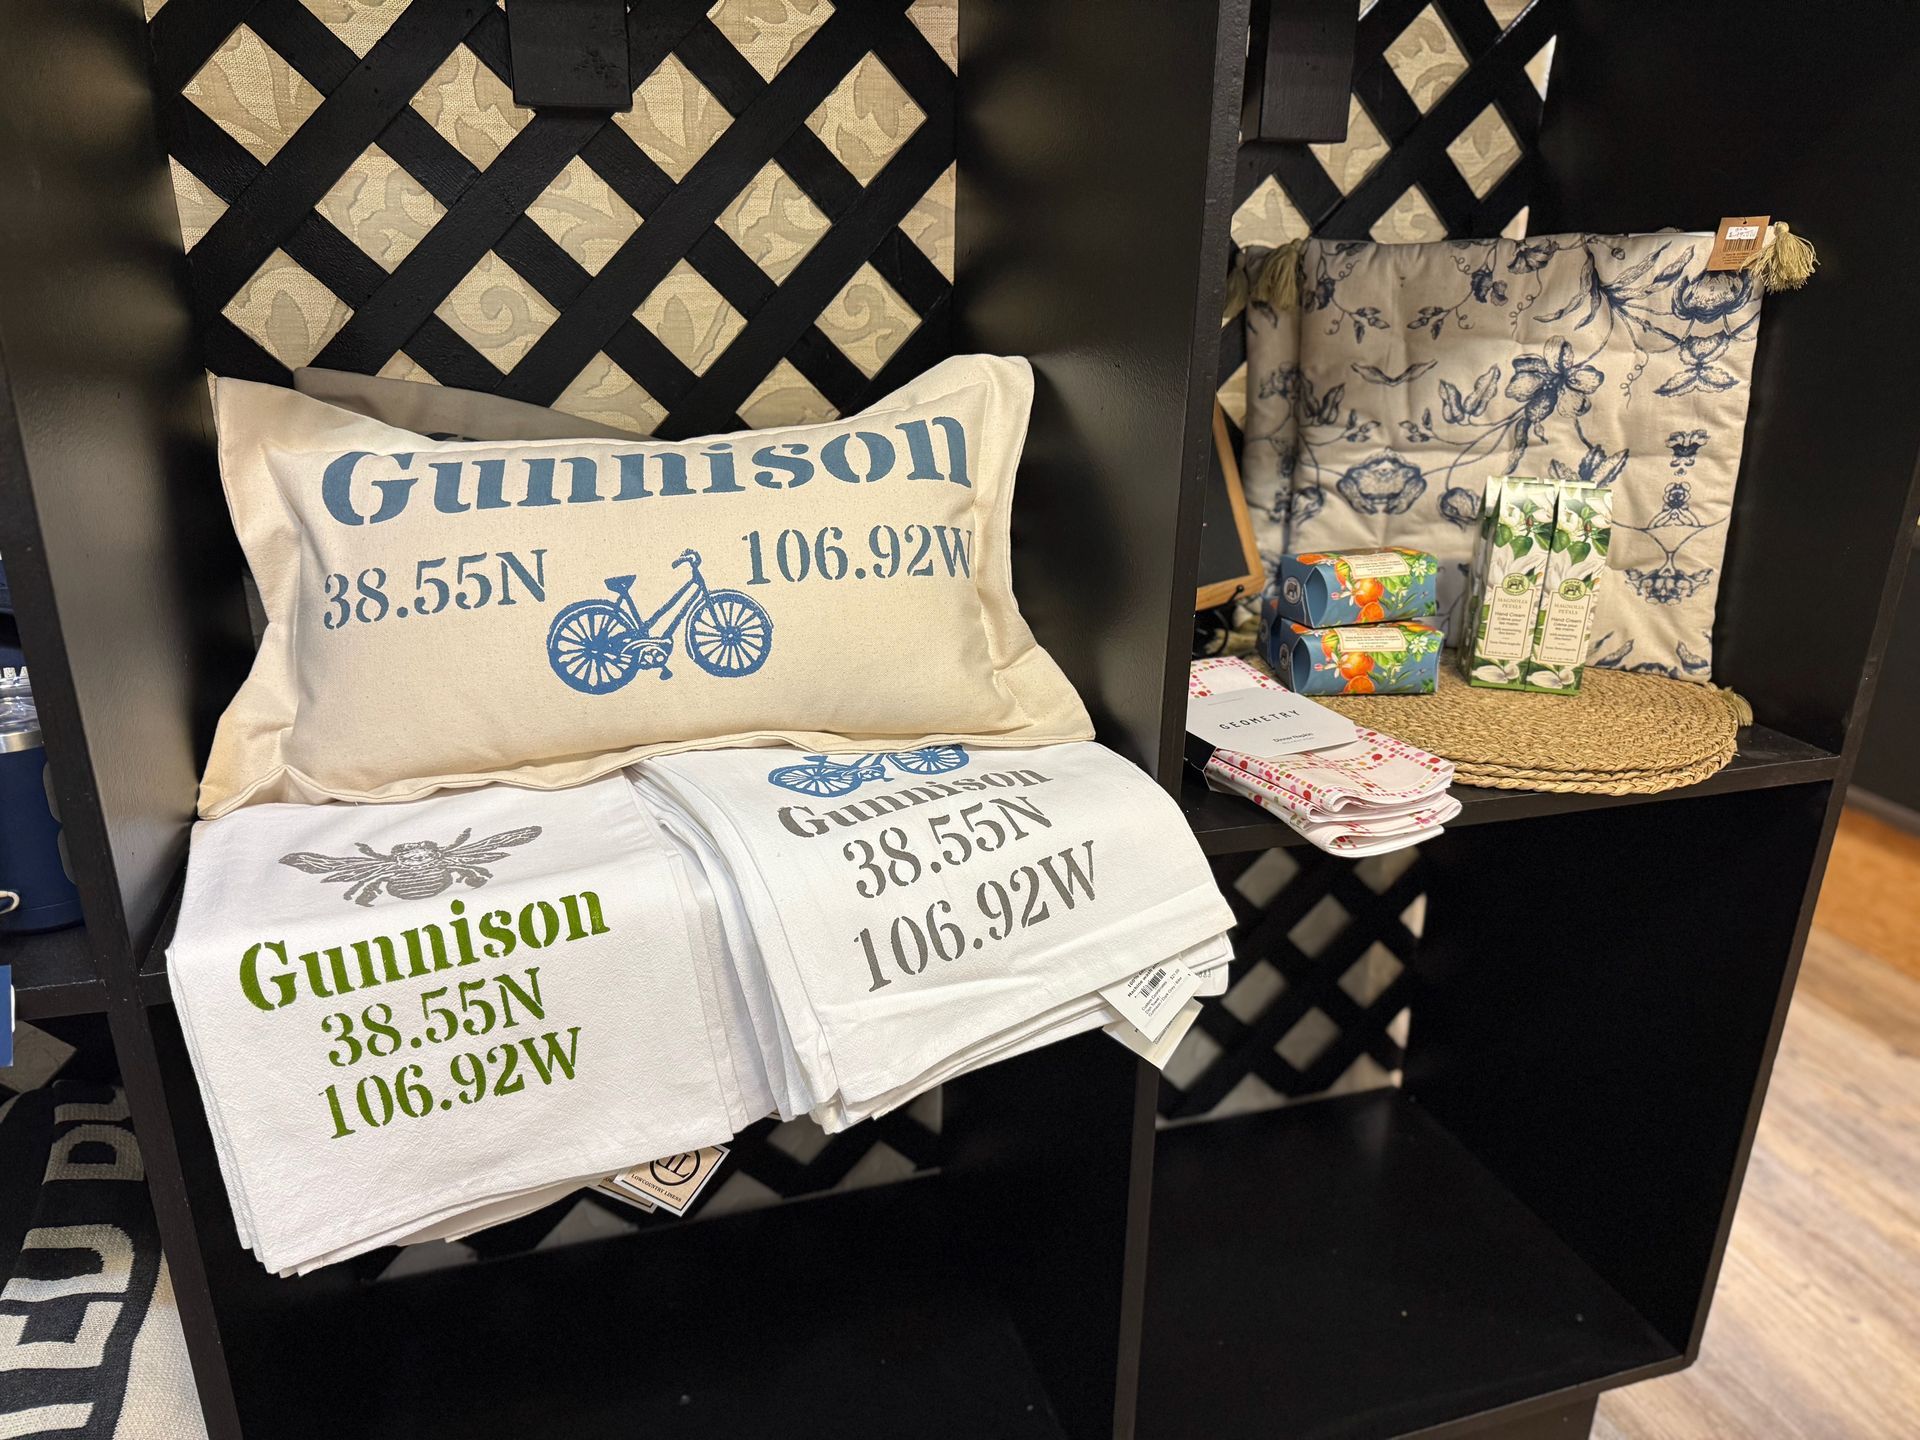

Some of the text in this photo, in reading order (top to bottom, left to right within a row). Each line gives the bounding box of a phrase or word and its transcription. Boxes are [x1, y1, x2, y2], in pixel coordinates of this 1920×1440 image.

[322, 415, 973, 526] Gunnison
[323, 548, 548, 631] 38.55N
[742, 523, 974, 586] 106.92W
[1219, 709, 1300, 730] GEOMETRY
[777, 769, 1054, 838] Gunnison
[842, 795, 1053, 899] 38.55N
[239, 890, 611, 1013] Gunnison
[853, 839, 1096, 993] 106.92W
[321, 966, 545, 1068] 38.55N
[318, 1026, 582, 1139] 106.92W
[631, 1173, 665, 1196] LOWCOUNTRY
[664, 1189, 682, 1203] LINENS
